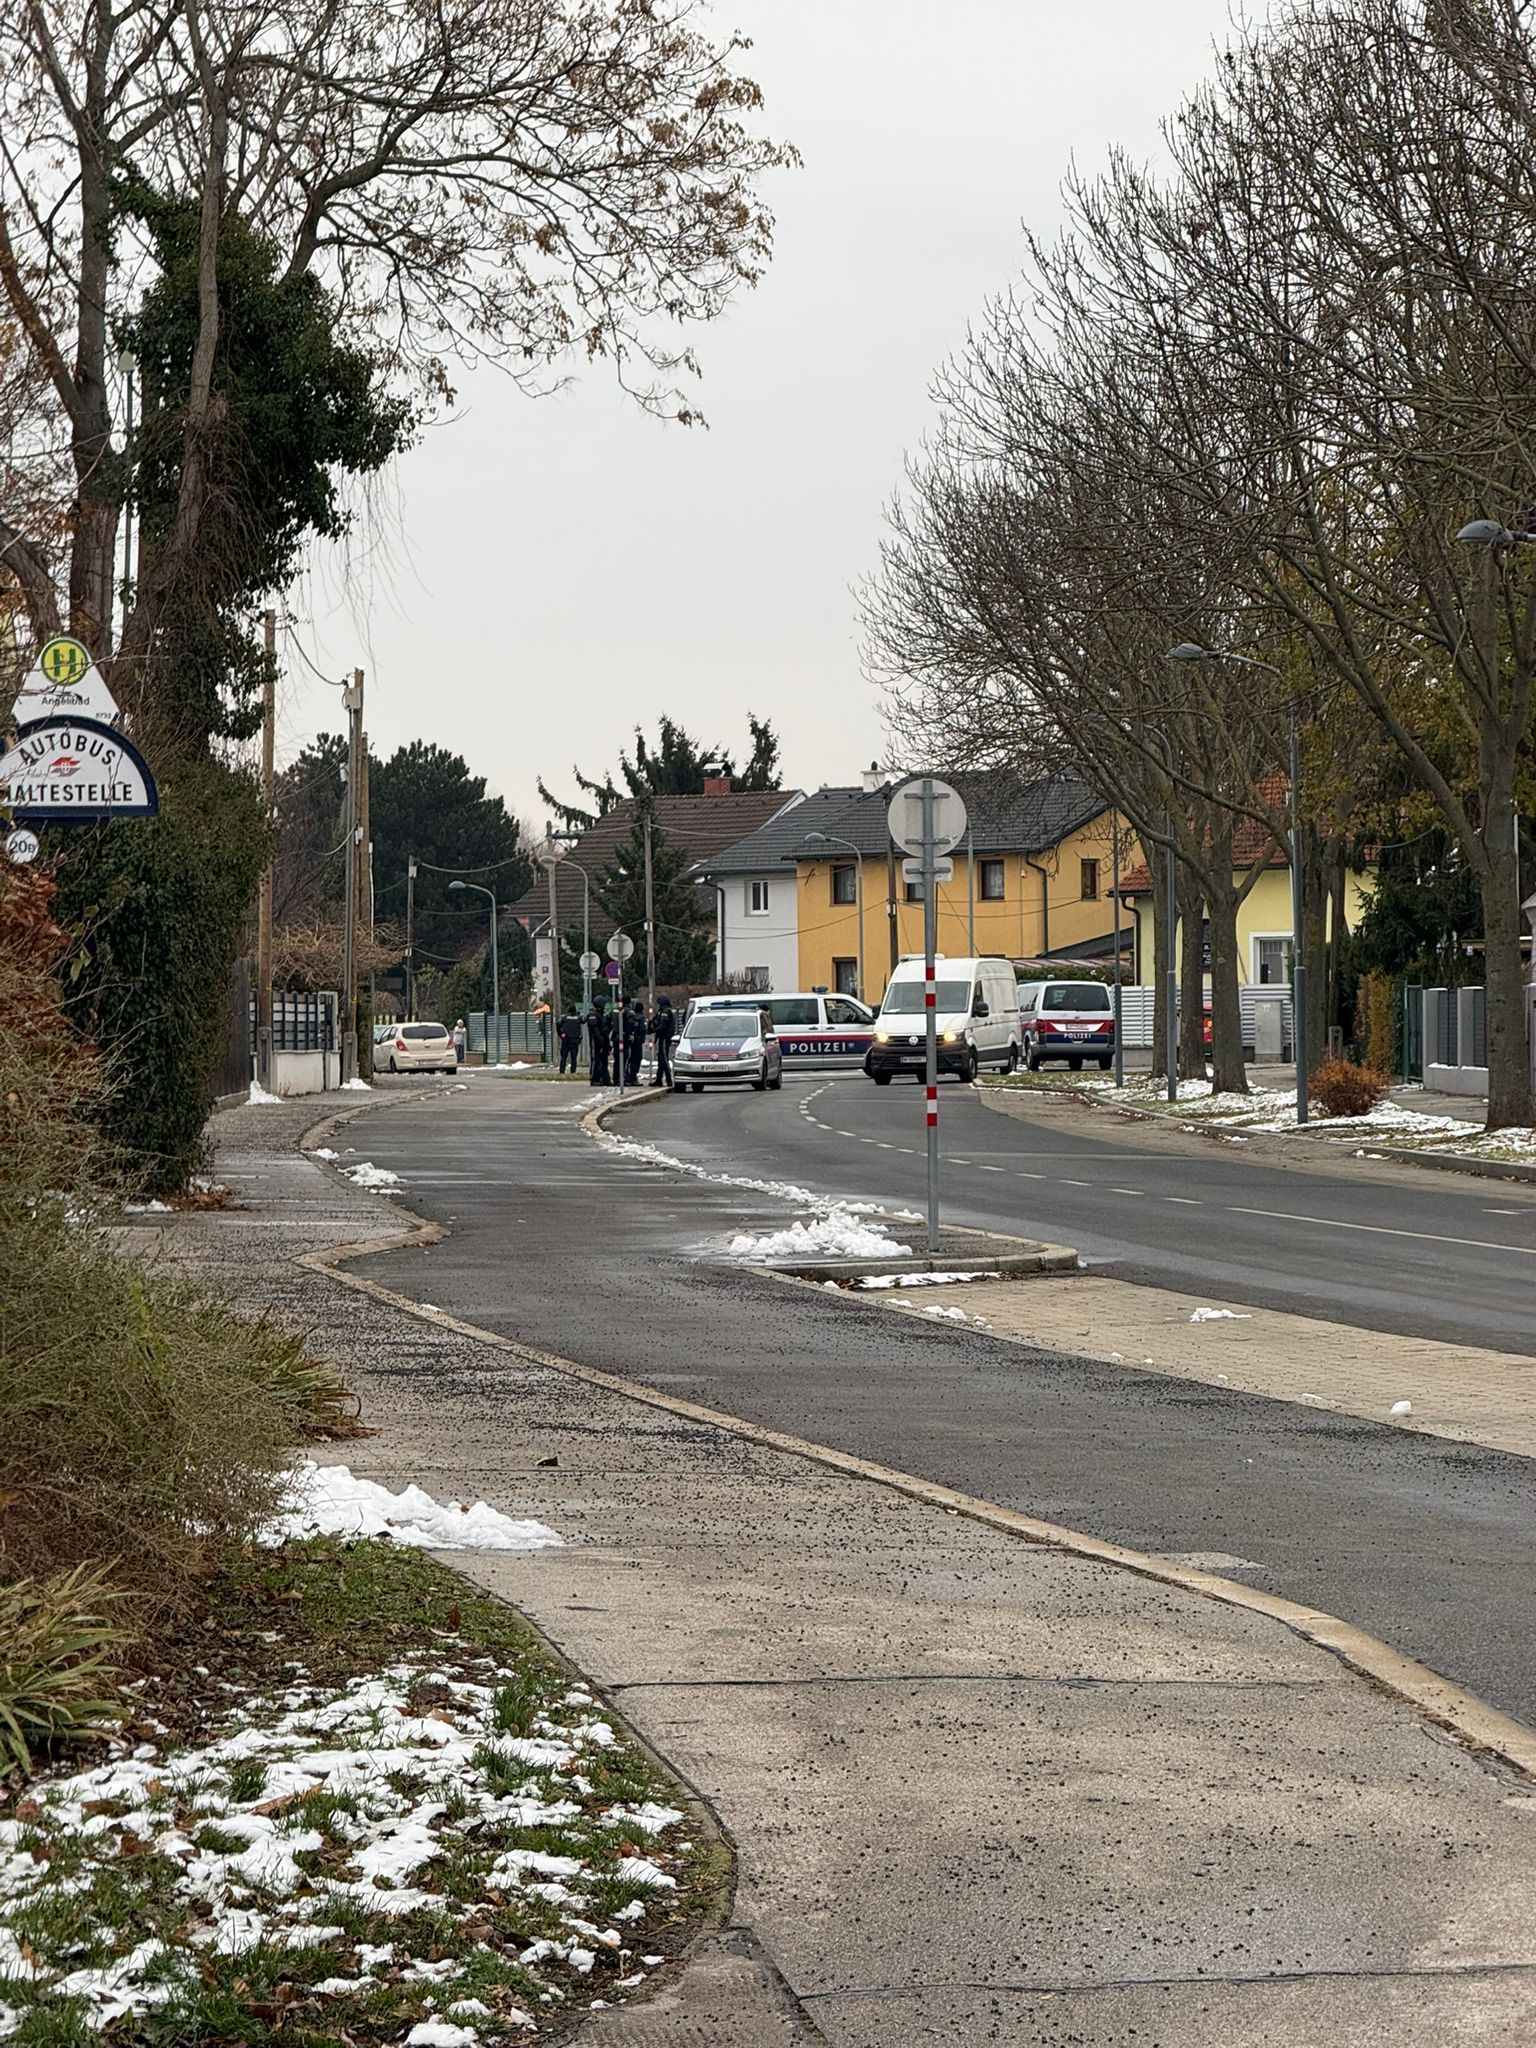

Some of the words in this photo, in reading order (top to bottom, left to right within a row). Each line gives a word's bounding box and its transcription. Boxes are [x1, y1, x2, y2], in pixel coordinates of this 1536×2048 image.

[53, 648, 76, 677] H
[19, 732, 117, 766] AUTOBUS
[1064, 1032, 1092, 1040] POLIZEI
[790, 1041, 847, 1054] POLIZEI
